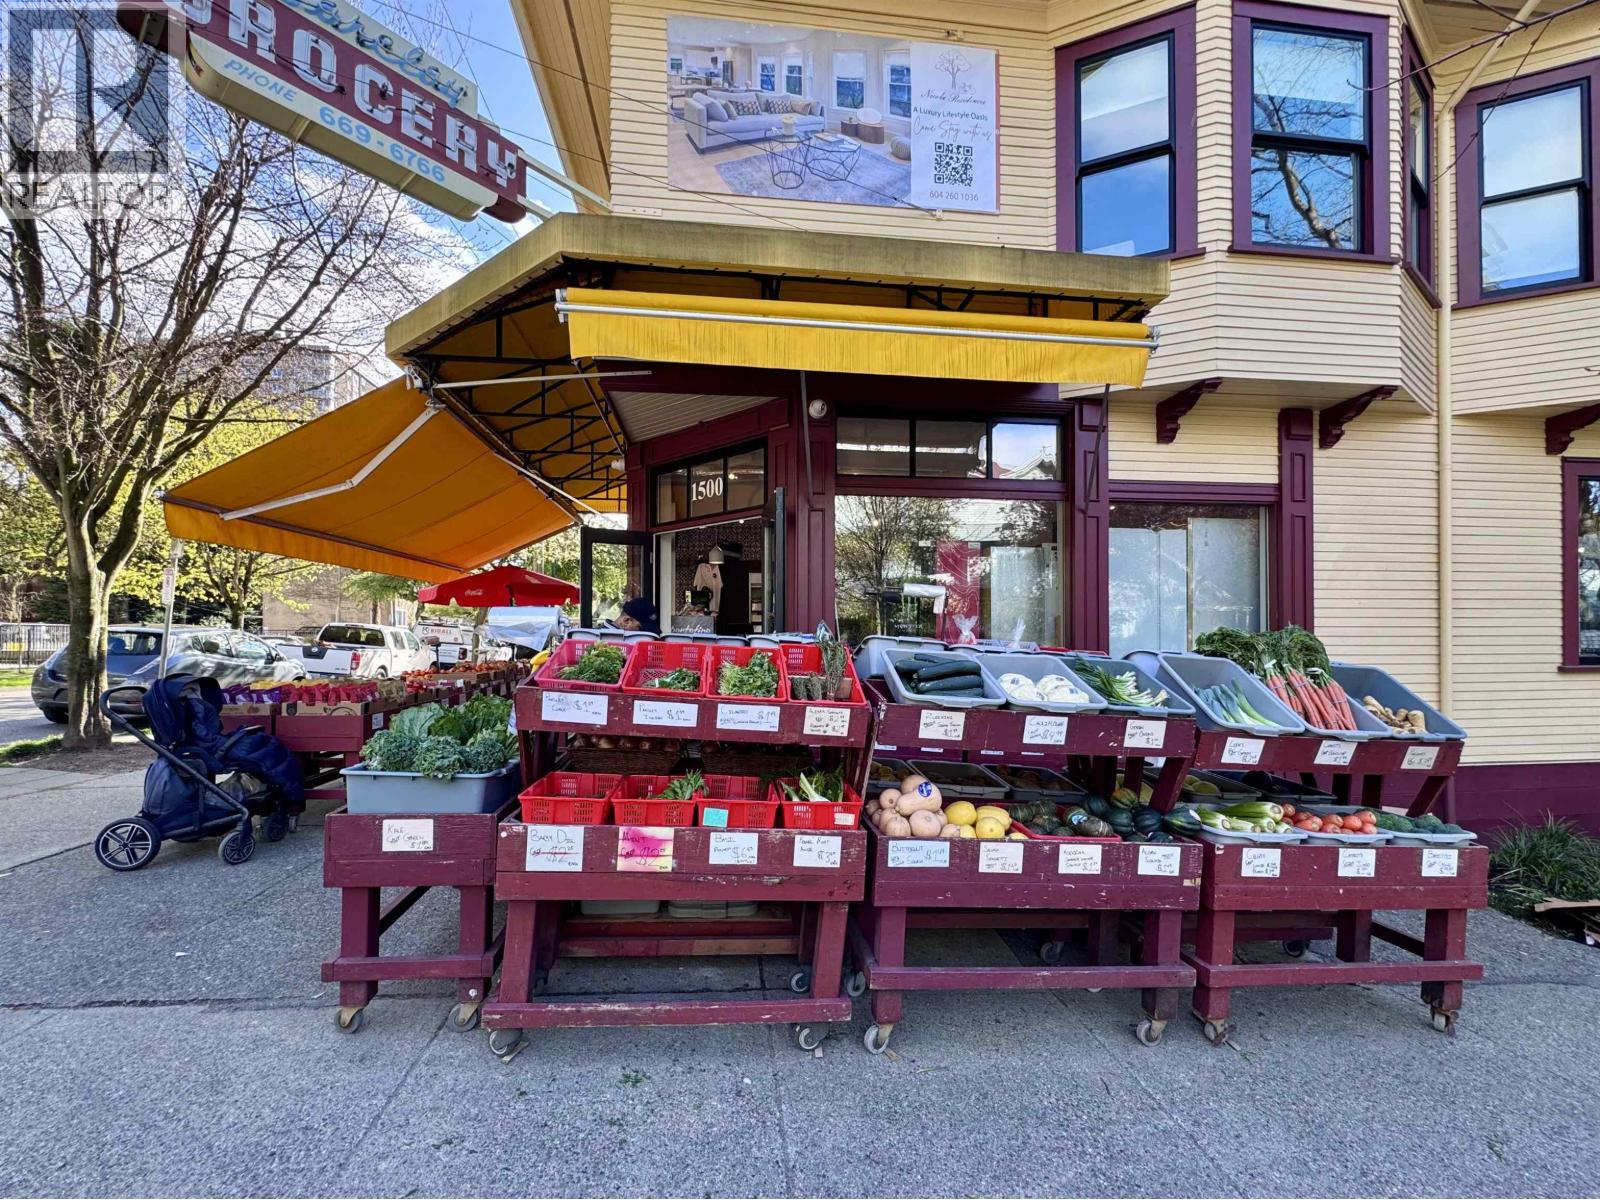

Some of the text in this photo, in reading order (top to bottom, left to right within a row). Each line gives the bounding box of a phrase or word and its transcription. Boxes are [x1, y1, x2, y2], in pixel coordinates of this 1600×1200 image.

[224, 59, 298, 102] PHONE
[920, 107, 941, 117] Luxury
[942, 111, 969, 119] Lifestyle
[970, 112, 988, 121] Oasis
[929, 190, 944, 199] 604
[945, 191, 959, 200] 260
[691, 476, 724, 500] 1500
